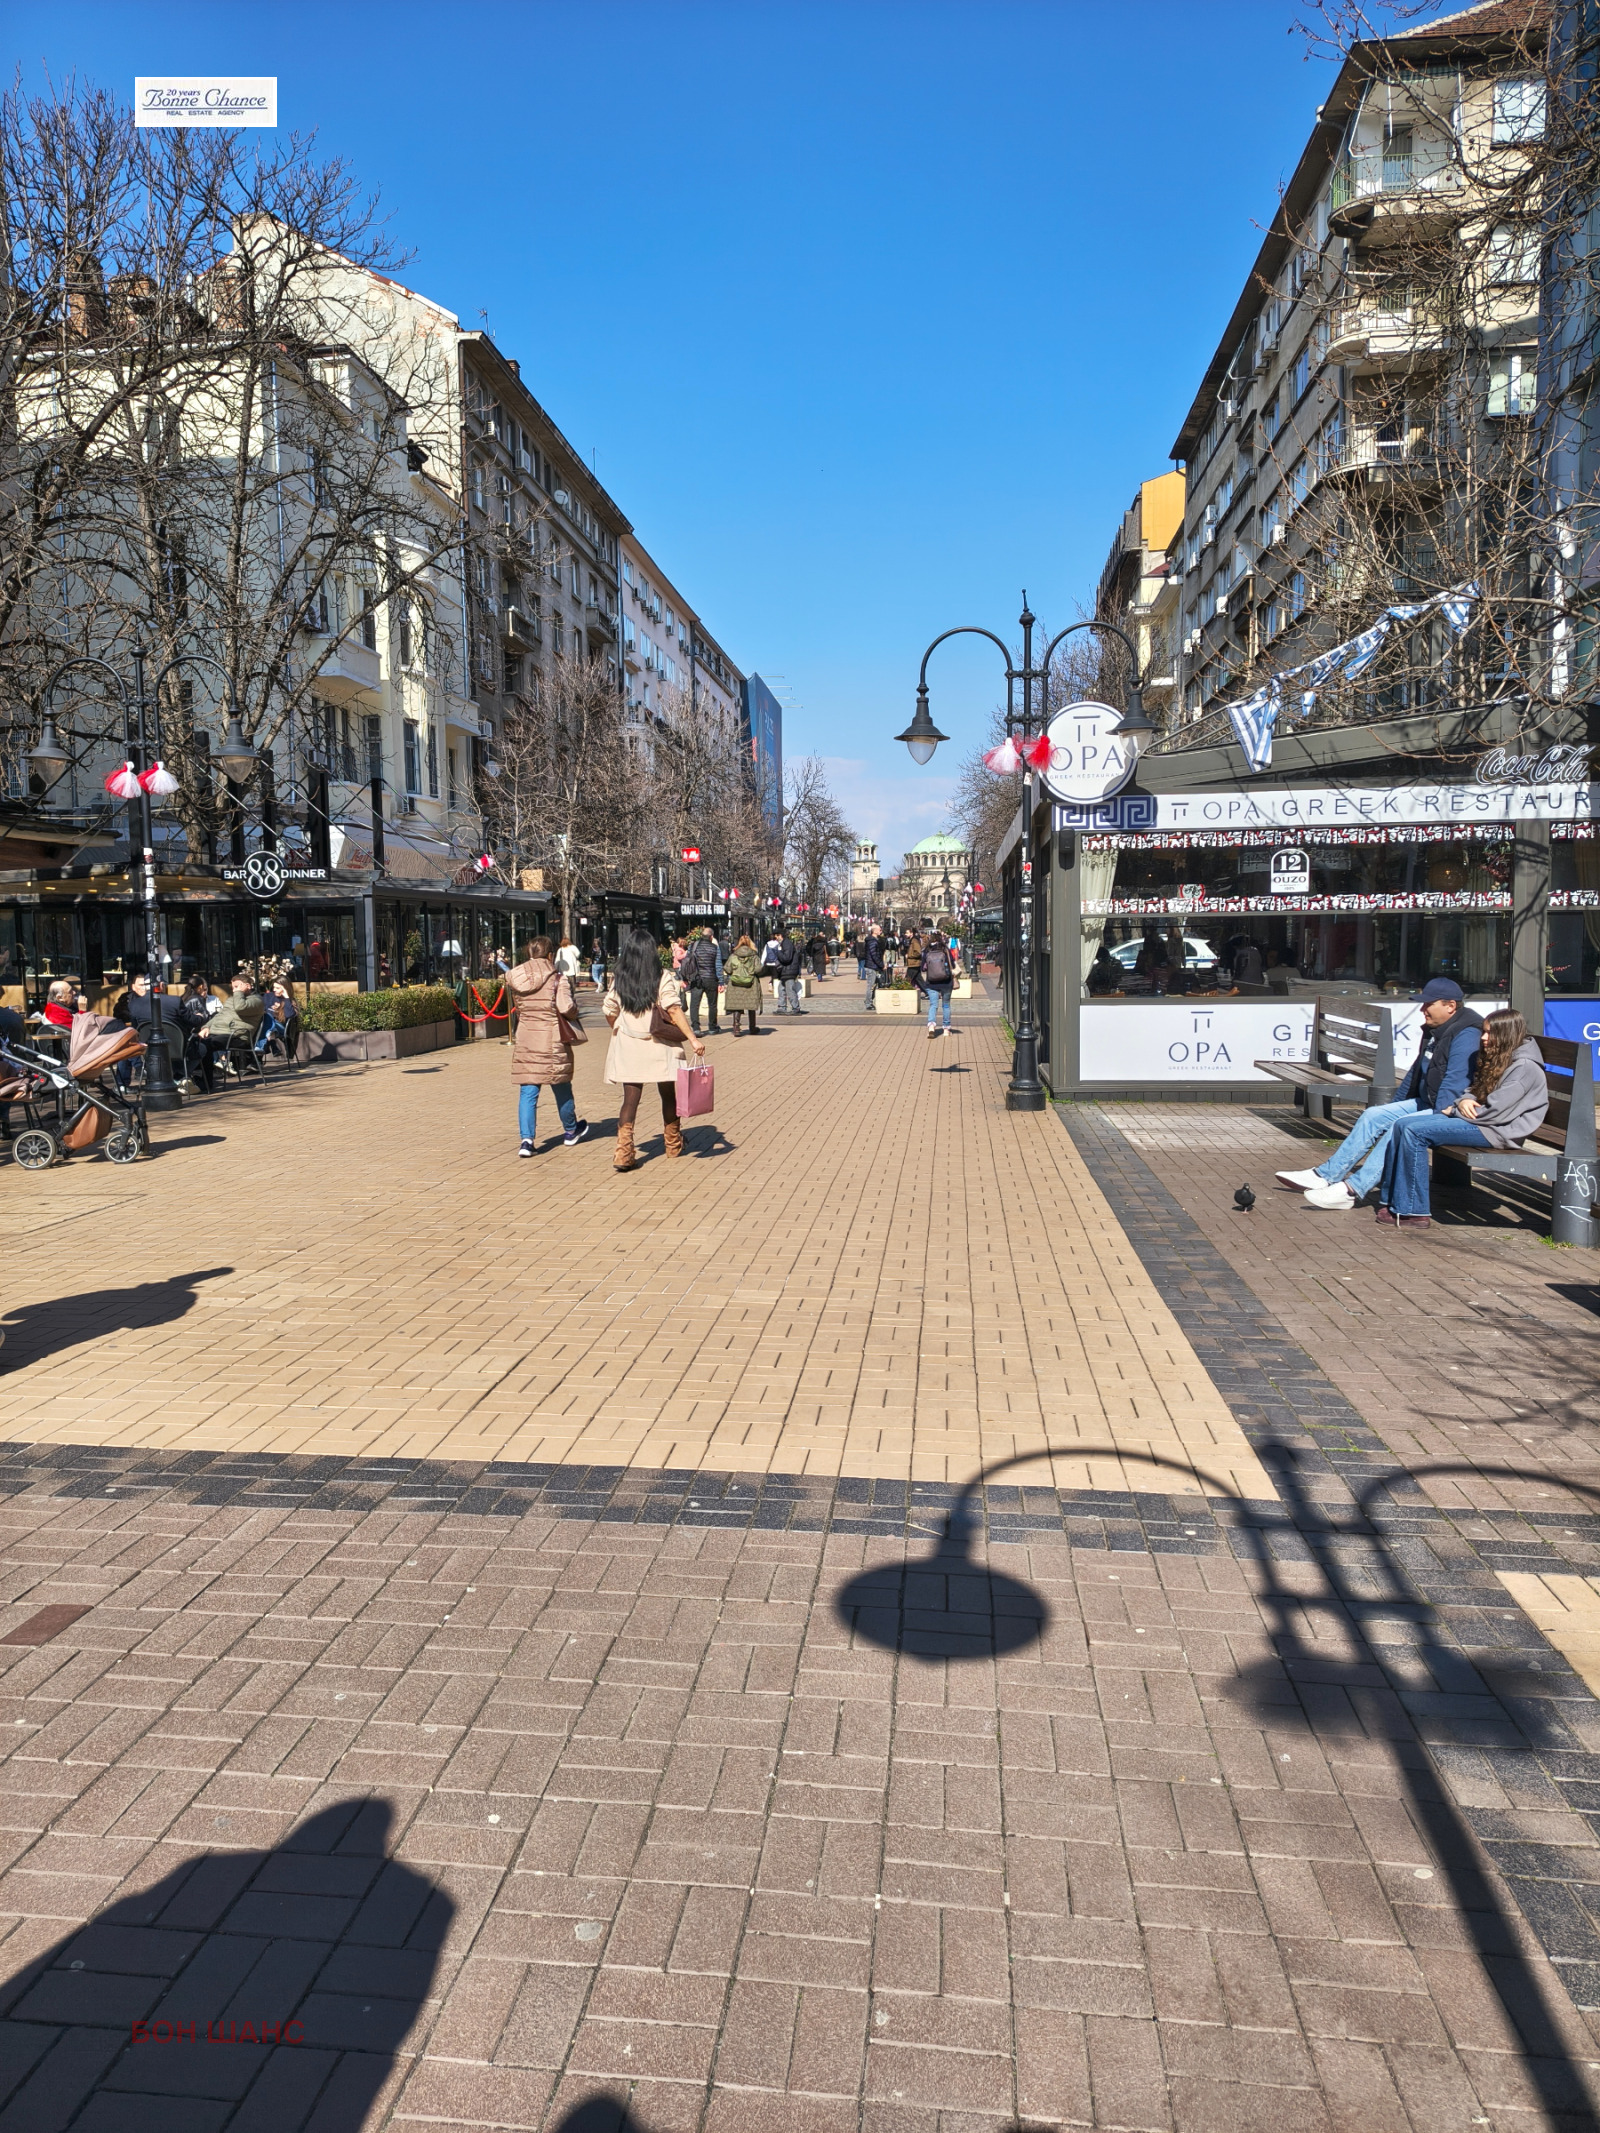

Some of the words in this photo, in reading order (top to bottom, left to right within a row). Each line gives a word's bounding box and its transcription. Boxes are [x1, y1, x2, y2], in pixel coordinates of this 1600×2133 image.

[1050, 744, 1124, 772] OPA
[1475, 744, 1596, 785] Coca-Cola
[1203, 801, 1260, 820] OPA
[1282, 796, 1399, 817] GREEK
[1424, 791, 1600, 813] RESTAUR
[1280, 854, 1302, 871] 12
[223, 870, 247, 880] BAR
[280, 868, 326, 879] DINNER
[1273, 875, 1307, 884] OUZO
[681, 905, 695, 915] CRAFT
[695, 905, 707, 915] BEER
[707, 905, 713, 915] &
[1168, 1041, 1232, 1063] OPA
